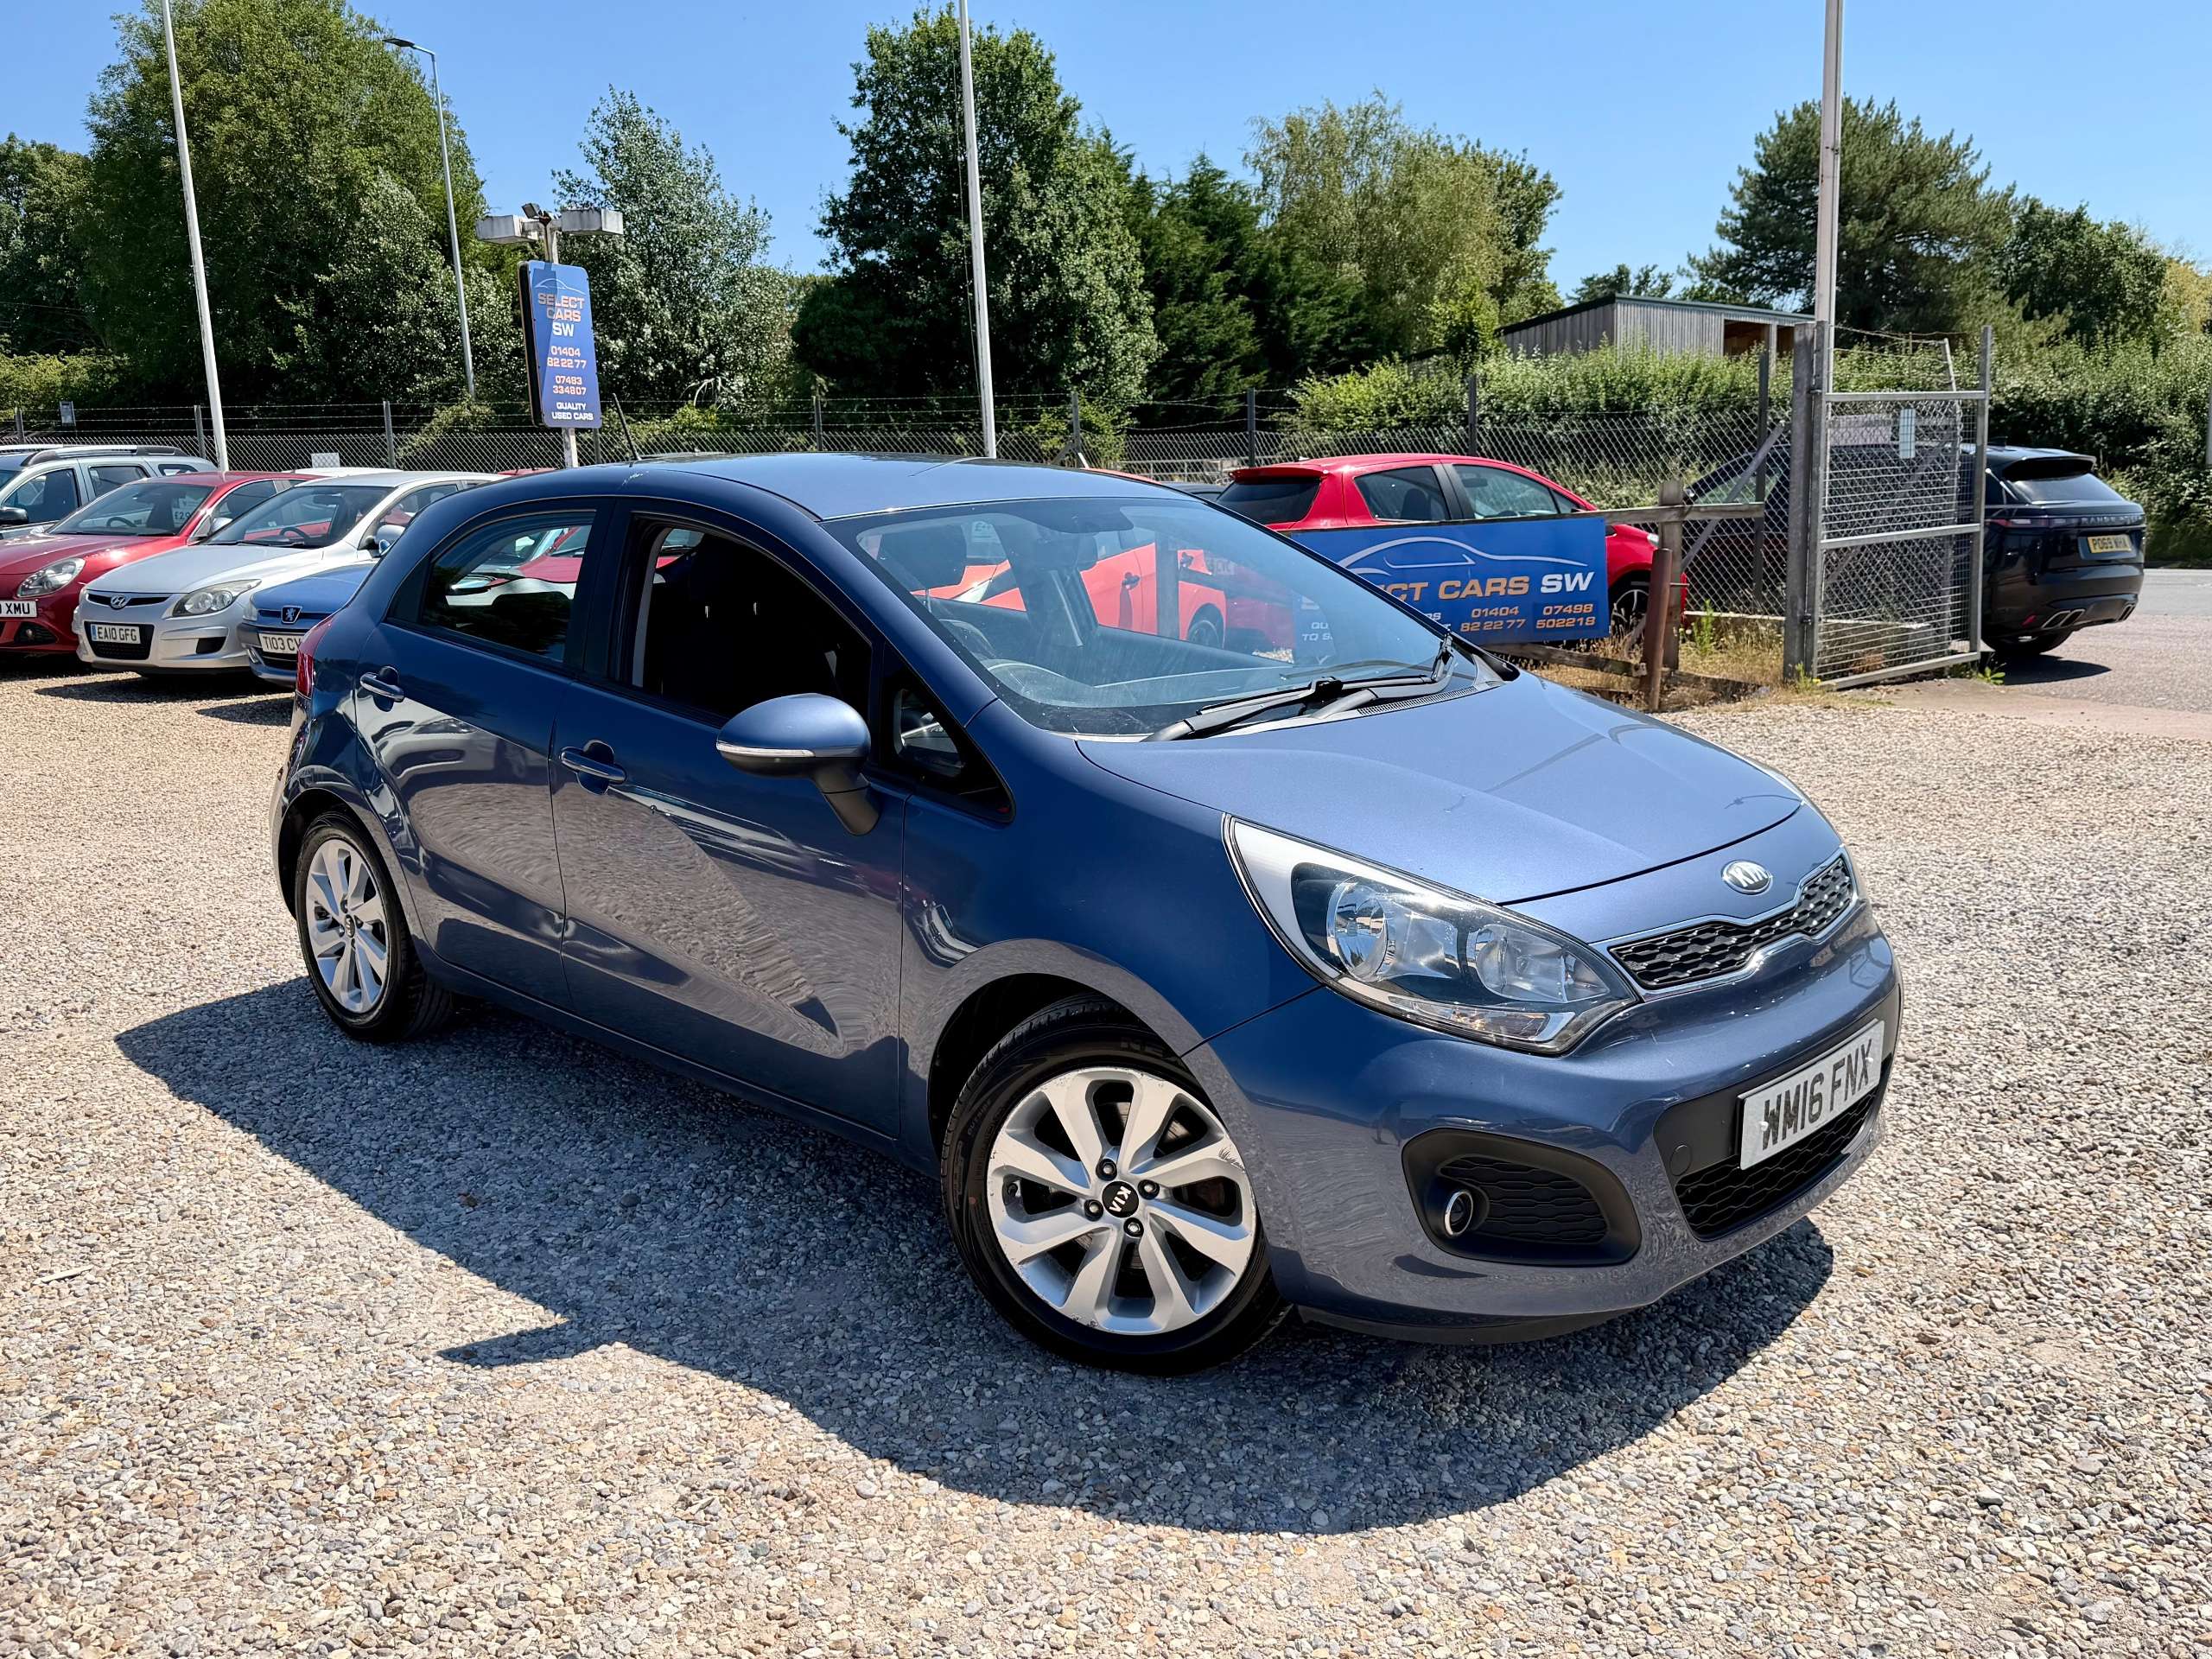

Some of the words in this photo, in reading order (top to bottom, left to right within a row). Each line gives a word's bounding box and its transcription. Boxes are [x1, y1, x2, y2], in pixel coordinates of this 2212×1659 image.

[537, 293, 585, 309] SELECT
[546, 307, 582, 322] CARS
[552, 321, 575, 337] SW
[550, 346, 581, 357] 01404
[556, 402, 586, 410] QUALITY
[551, 411, 572, 420] USED
[573, 412, 594, 421] CARS
[1380, 582, 1429, 601] CT
[1438, 575, 1529, 600] CARS
[1541, 571, 1595, 594] SW
[5, 602, 30, 614] XMU
[1471, 606, 1519, 618] 01404
[1542, 604, 1593, 616] 07498
[1535, 616, 1596, 629] 502218
[97, 626, 117, 640] EA10
[118, 627, 137, 641] GFG
[263, 636, 285, 651] T103
[1763, 1071, 1824, 1150] WM16
[1829, 1039, 1872, 1112] FNX
[1109, 1185, 1132, 1212] KIA
